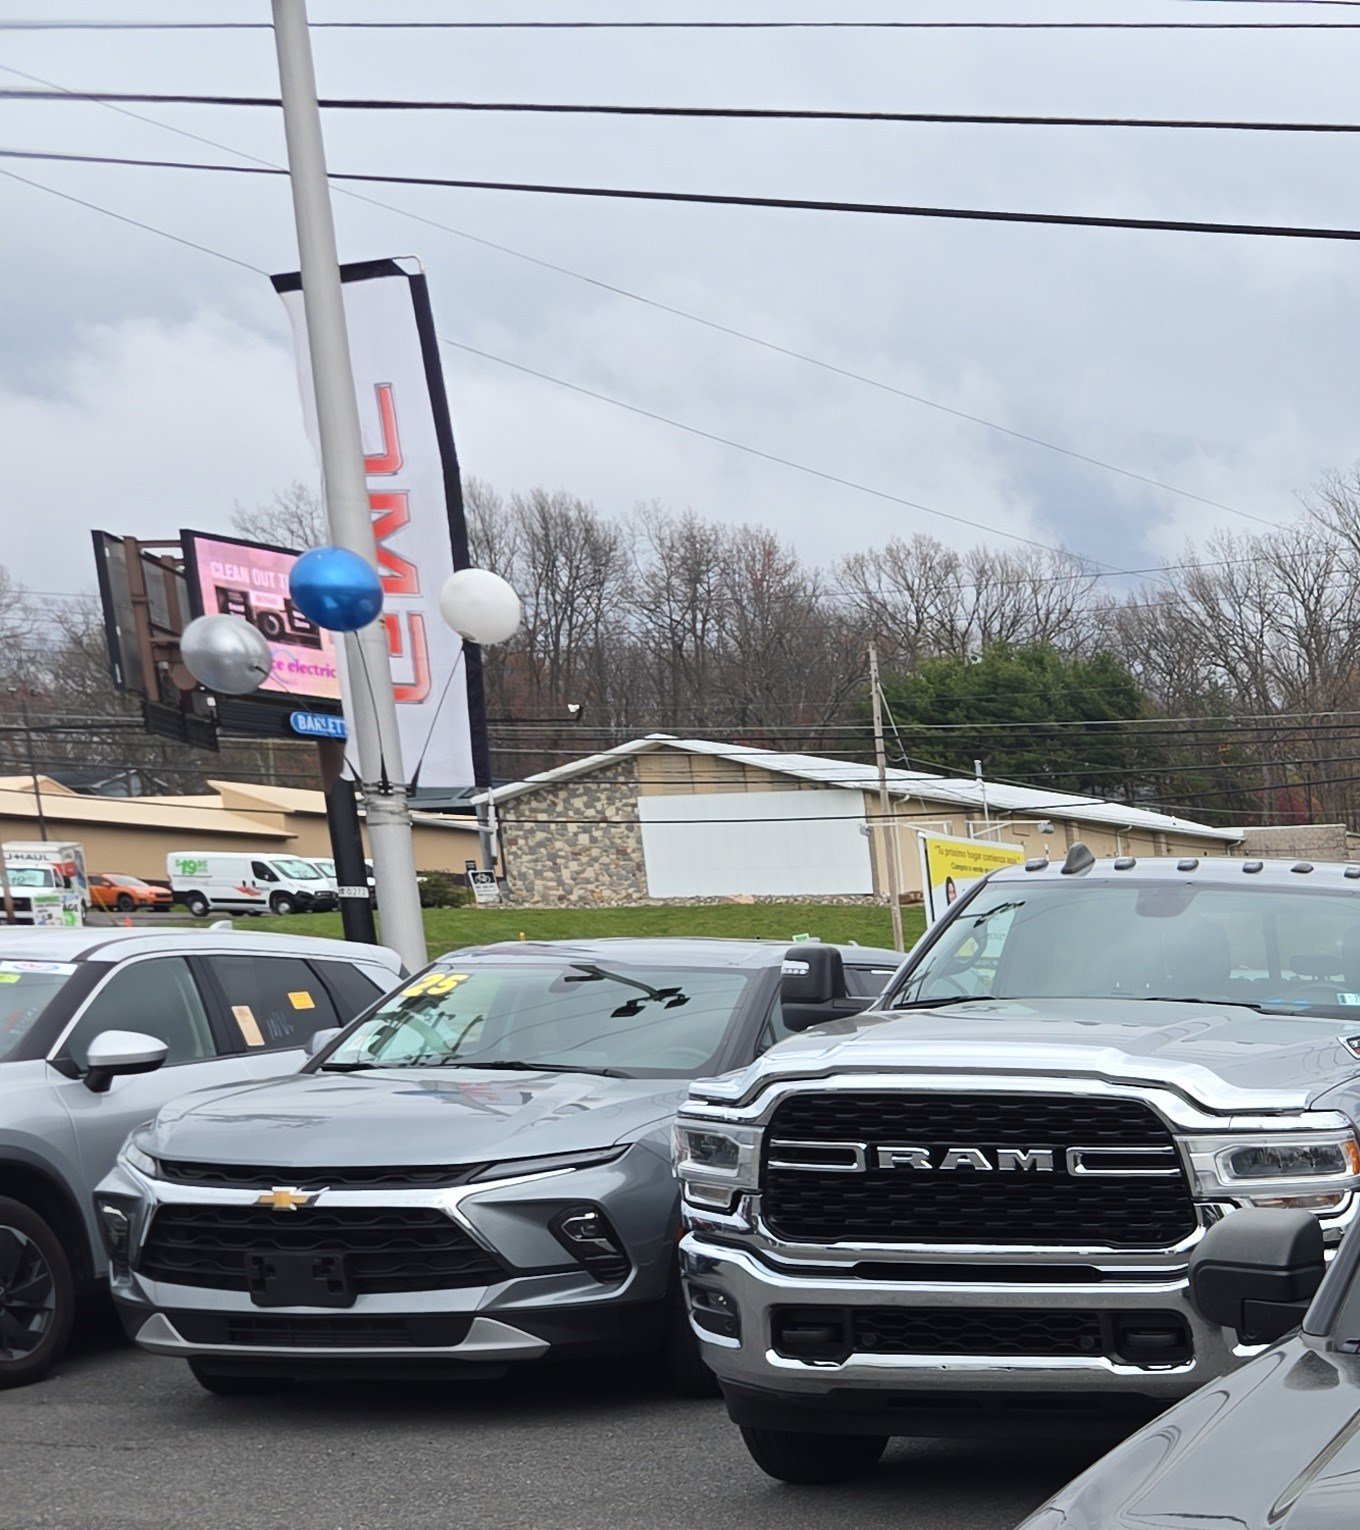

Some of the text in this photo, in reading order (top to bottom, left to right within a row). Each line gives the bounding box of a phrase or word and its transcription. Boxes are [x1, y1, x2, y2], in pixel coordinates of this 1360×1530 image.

[210, 561, 250, 583] CLEAN
[253, 569, 276, 588] OUT
[288, 659, 337, 678] electric
[402, 973, 470, 998] 25
[876, 1146, 1054, 1172] RAM
